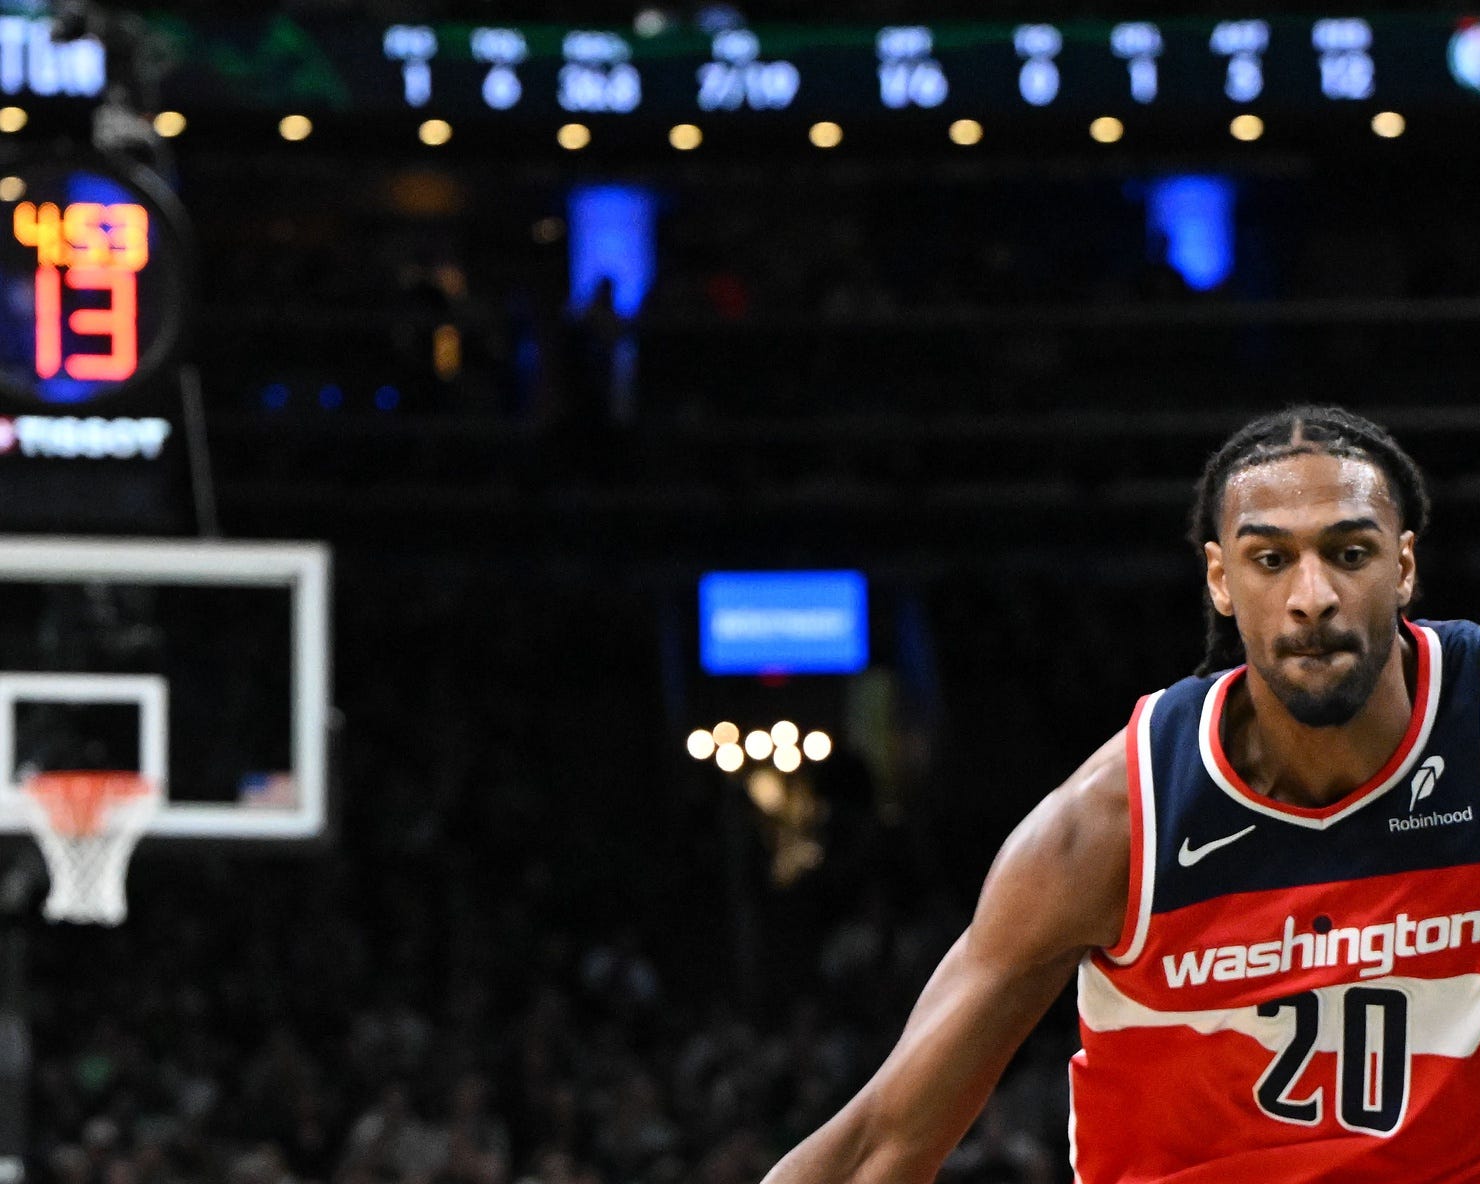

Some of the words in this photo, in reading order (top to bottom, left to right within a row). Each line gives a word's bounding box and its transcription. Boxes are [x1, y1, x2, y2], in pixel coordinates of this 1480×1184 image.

[35, 264, 137, 381] 13
[1388, 805, 1473, 832] Robinhood
[1252, 985, 1412, 1138] 20
